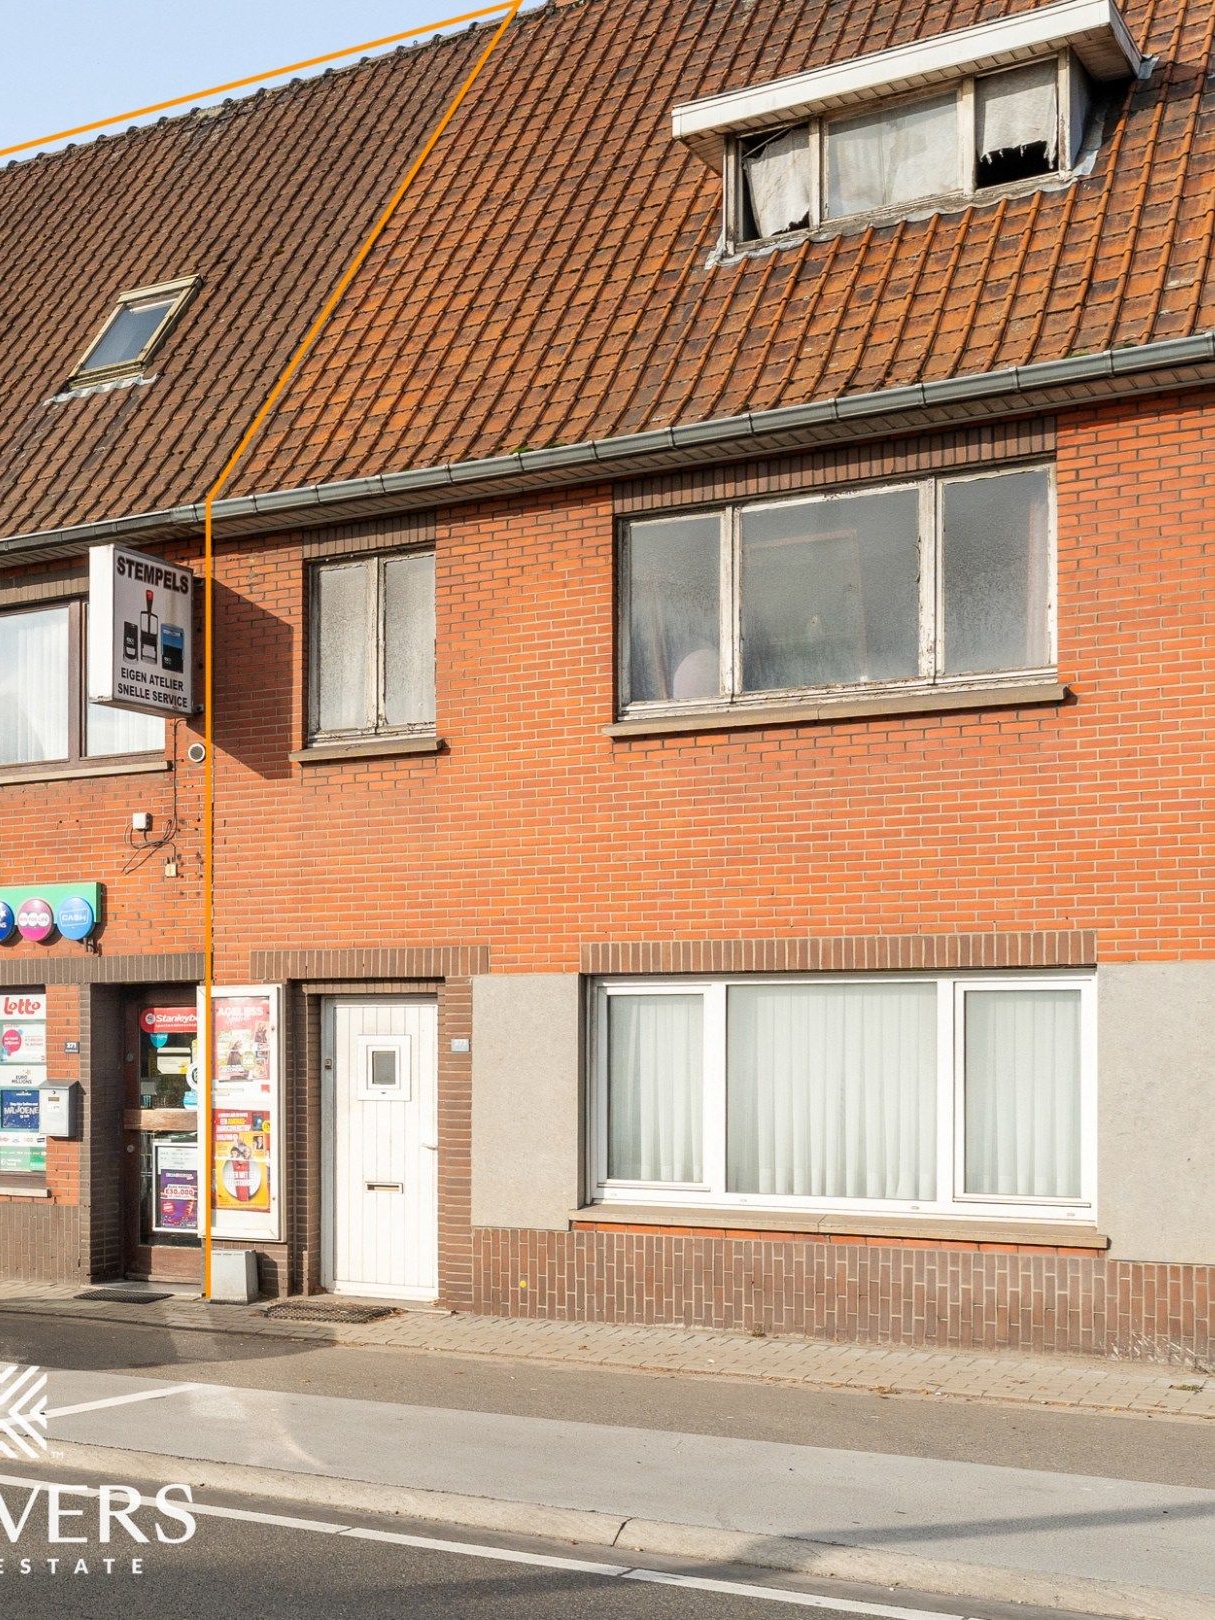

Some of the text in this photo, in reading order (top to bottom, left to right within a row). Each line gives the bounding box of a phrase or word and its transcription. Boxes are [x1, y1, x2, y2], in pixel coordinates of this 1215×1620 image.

[117, 555, 189, 594] STEMPELS
[121, 667, 184, 692] EIGEN ATELIER
[118, 683, 188, 708] SNELLE SERVICE
[155, 1013, 197, 1024] Stanleyb
